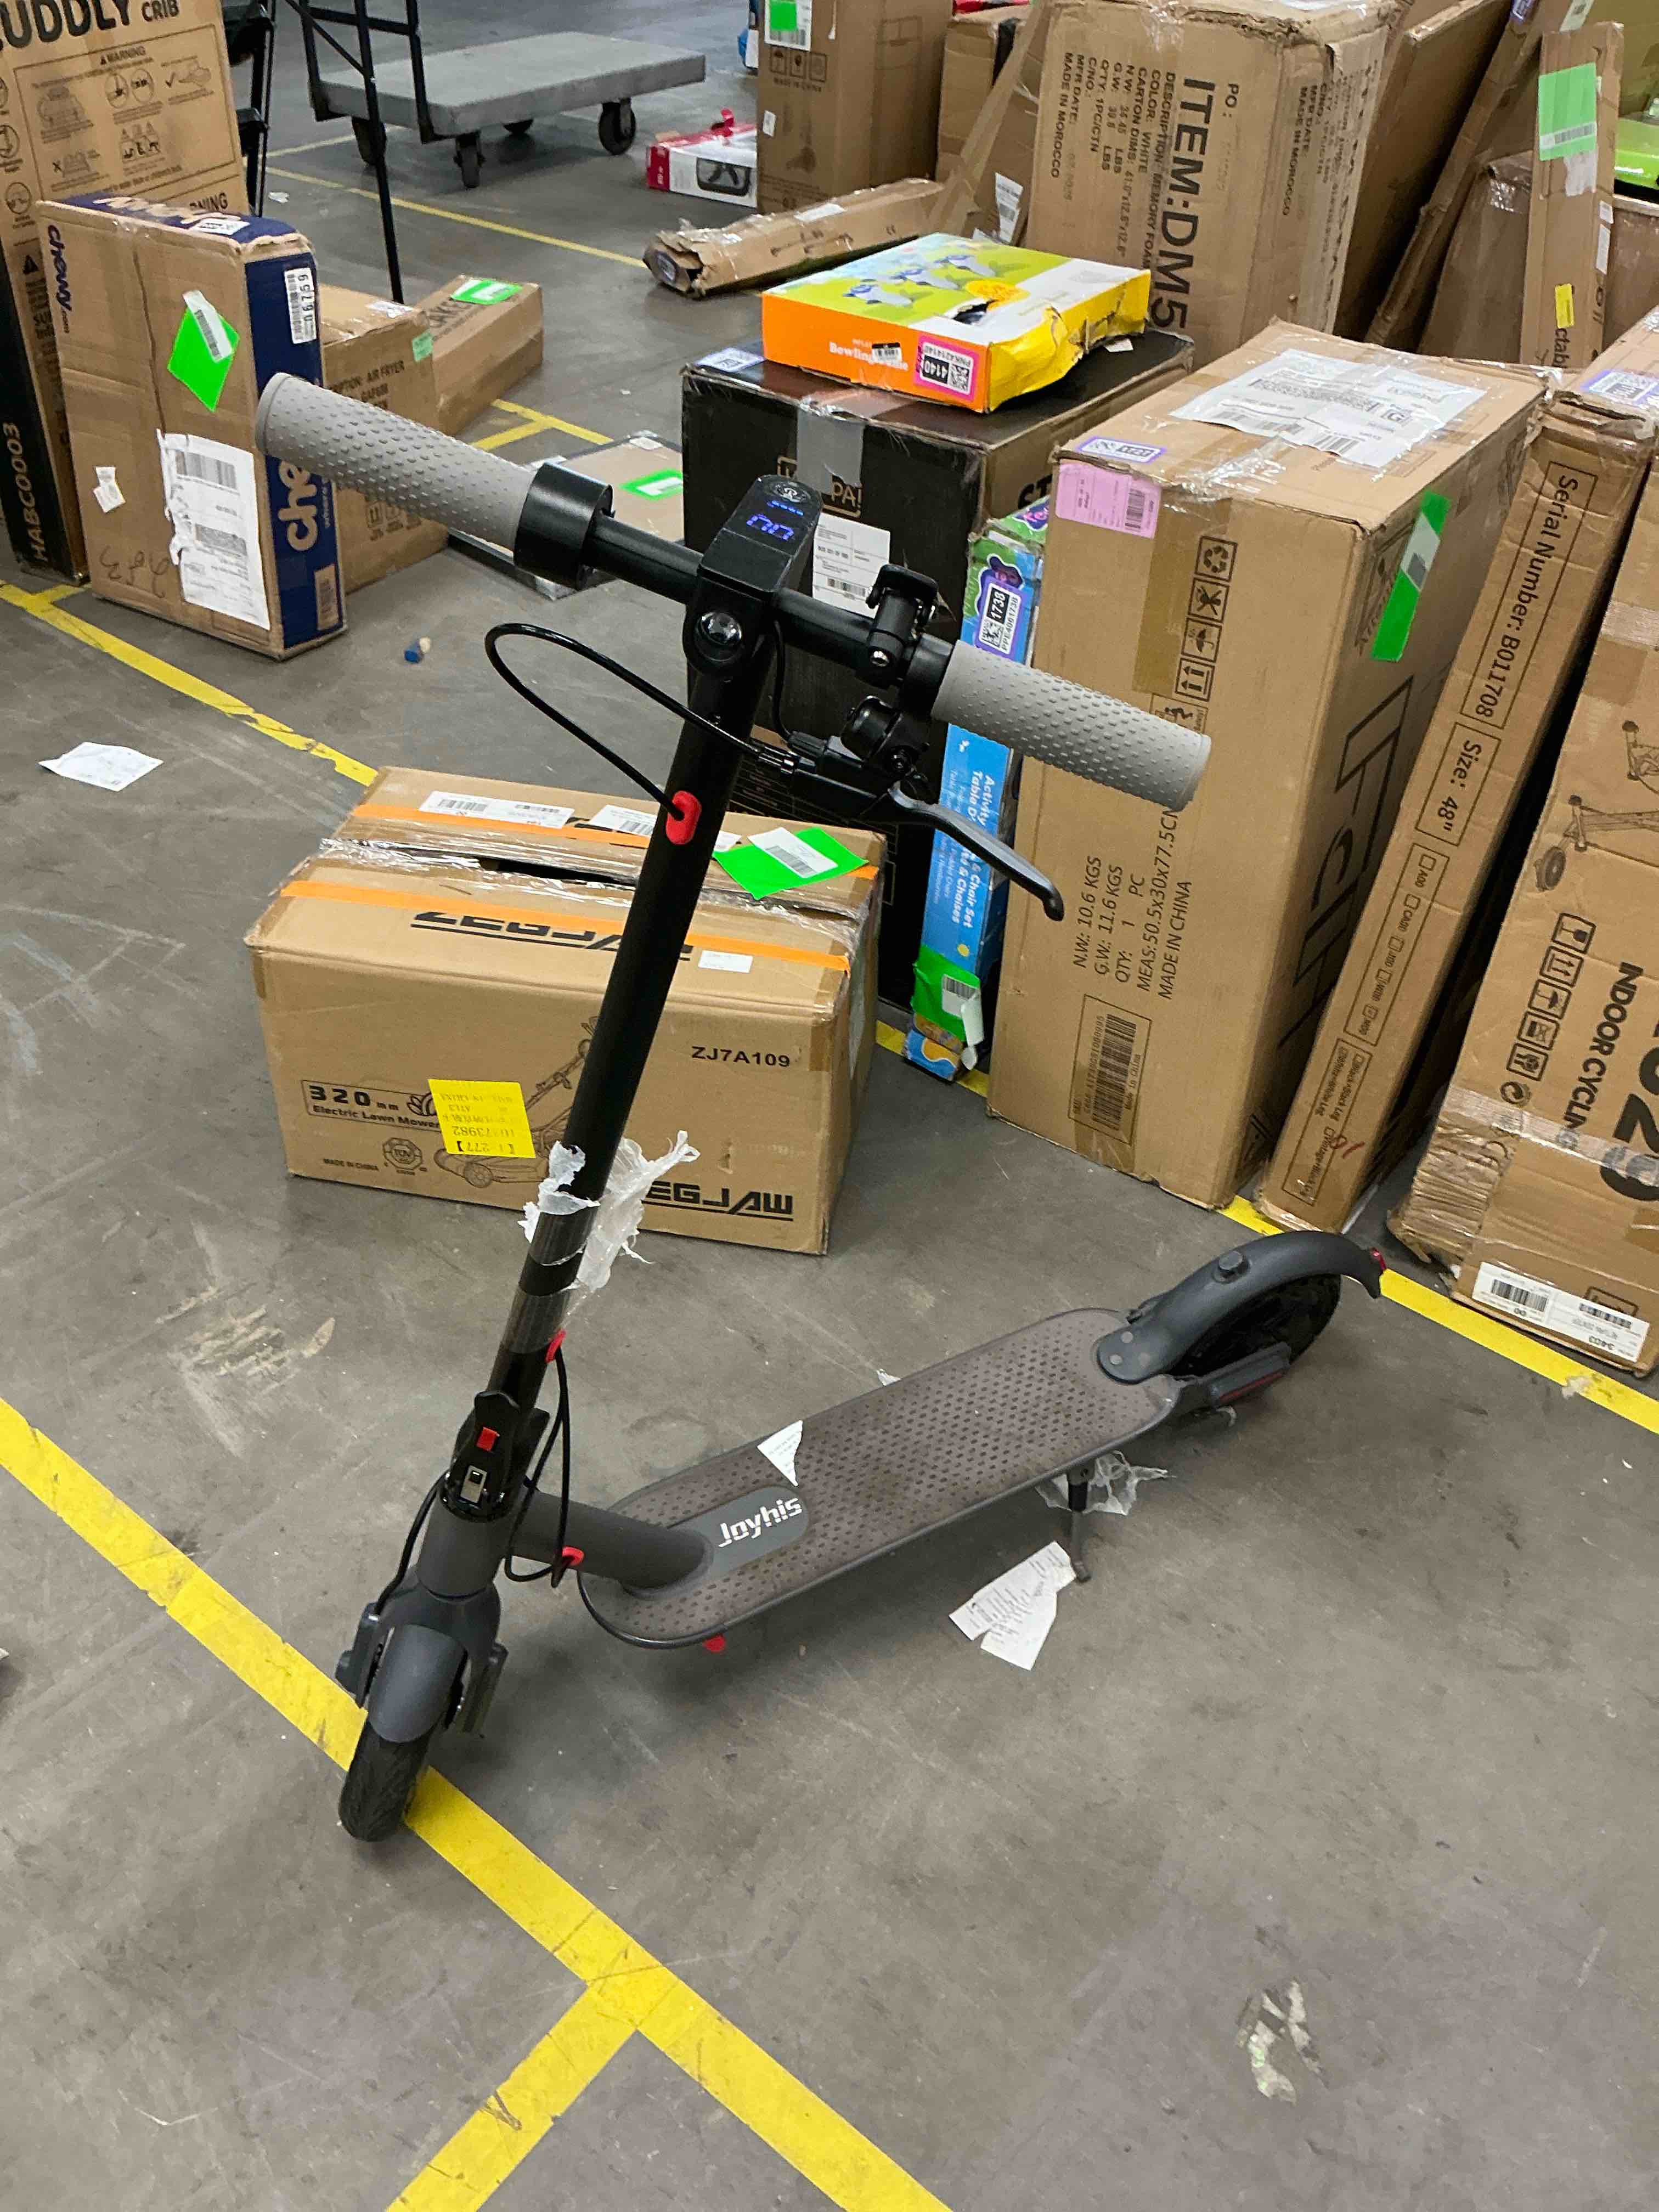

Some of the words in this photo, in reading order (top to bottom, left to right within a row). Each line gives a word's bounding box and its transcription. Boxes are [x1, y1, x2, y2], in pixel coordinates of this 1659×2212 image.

[0, 0, 130, 48] UDDLY
[1061, 52, 1074, 90] MADE
[1059, 93, 1069, 108] IN
[1132, 67, 1147, 125] CARTON
[1050, 110, 1066, 177] MOROCCO
[1138, 131, 1152, 173] WHITE
[279, 460, 319, 551] che
[1544, 475, 1578, 538] Serial
[1508, 541, 1556, 629] Number:
[991, 590, 1006, 620] 1738
[1475, 634, 1521, 718] B011708
[1450, 739, 1482, 790] Size:
[966, 769, 983, 806] Table
[977, 775, 995, 826] Activity
[1437, 795, 1460, 832] 48"
[967, 873, 981, 906] Chair
[1084, 856, 1102, 888] KGS
[1105, 865, 1123, 896] KGS
[950, 878, 967, 924] Chaises
[962, 906, 975, 928] Set
[1077, 891, 1096, 928] 10.6
[1098, 898, 1116, 934] 11.6
[1174, 881, 1192, 930] CHINA
[1115, 951, 1133, 983] QTY:
[1128, 876, 1145, 898] PC
[1170, 933, 1183, 955] IN
[1158, 959, 1178, 1000] MADE
[1589, 961, 1644, 1056] INDOOR
[691, 1045, 791, 1068] ZJ7A109
[309, 1085, 371, 1107] 320
[313, 1105, 361, 1118] Electric
[362, 1110, 395, 1123] Lawn
[646, 1180, 793, 1216] EGJAW
[718, 1497, 803, 1548] Joyhis
